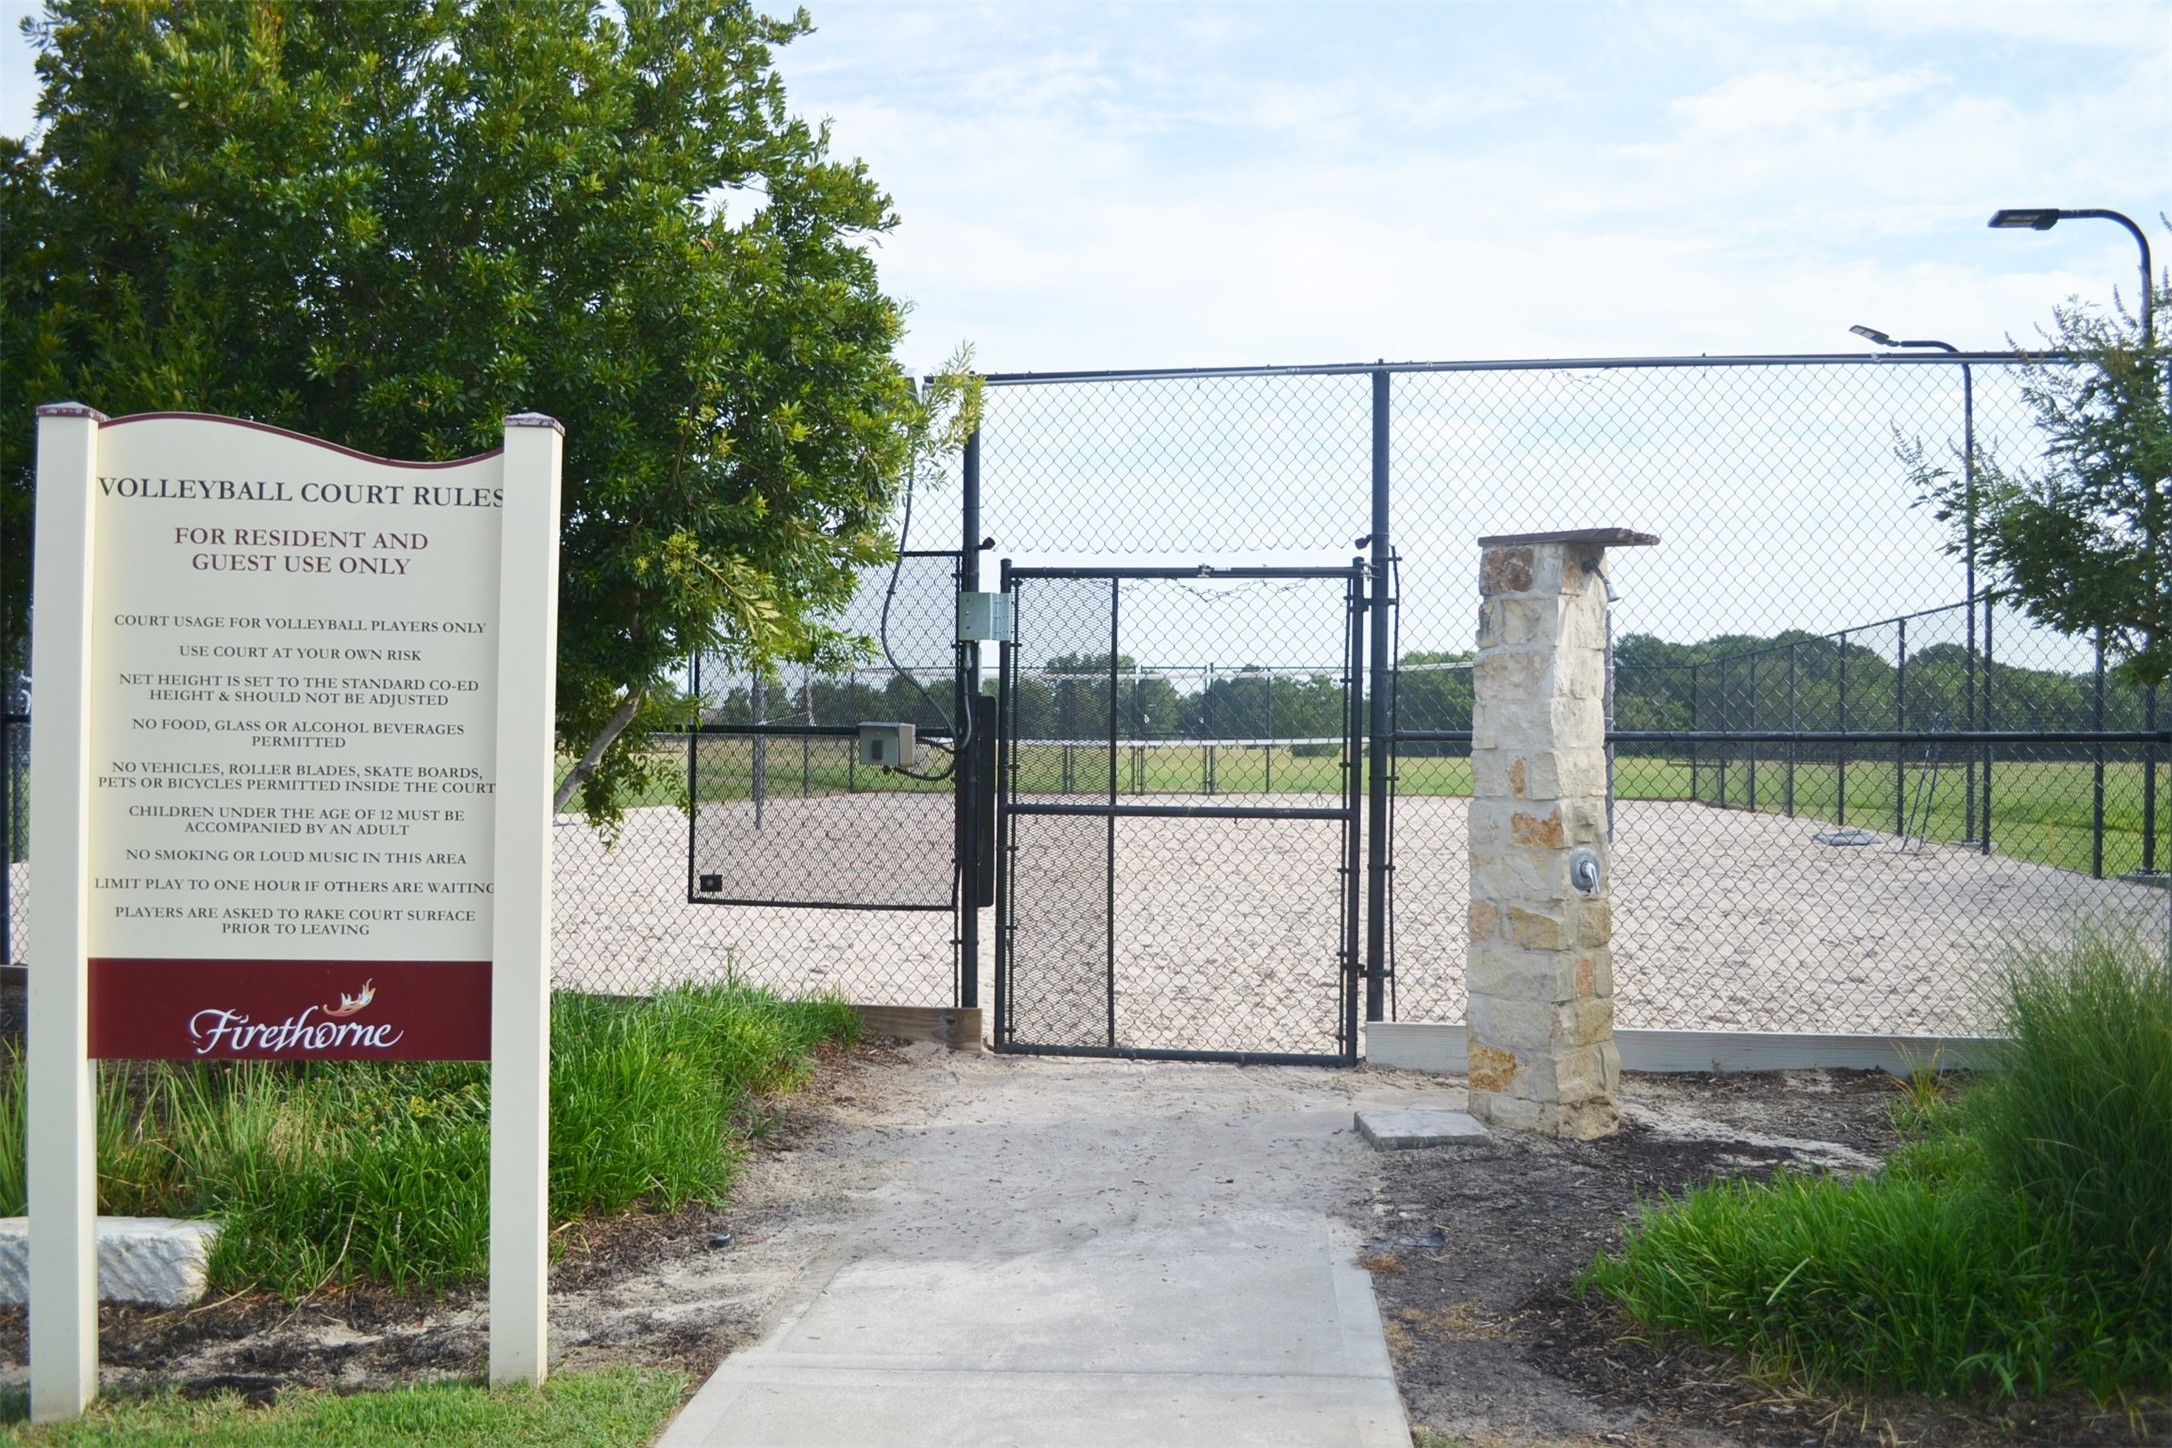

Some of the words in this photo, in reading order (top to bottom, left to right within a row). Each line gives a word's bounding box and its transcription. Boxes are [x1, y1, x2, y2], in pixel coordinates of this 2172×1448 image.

[96, 476, 294, 502] VOLLEYBALL
[300, 482, 405, 505] COURT
[412, 485, 503, 509] RULES
[173, 526, 227, 546] FOR
[233, 528, 367, 549] RESIDENT
[371, 531, 429, 551] AND
[191, 552, 277, 572] GUEST
[283, 555, 332, 574] USE
[338, 556, 412, 576] ONLY
[114, 614, 170, 627] COURT
[173, 615, 226, 628] USAGE
[228, 616, 262, 629] FOR
[264, 617, 368, 632] VOLLEYBALL
[371, 619, 439, 633] PLAYERS
[442, 621, 487, 634] ONLY
[179, 645, 210, 657] USE
[212, 645, 269, 659] COURT
[271, 647, 294, 659] AT
[295, 647, 341, 660] YOUR
[344, 648, 383, 661] OWN
[386, 649, 422, 662] RISK
[119, 672, 154, 685] NET
[157, 673, 224, 687] HEIGHT
[226, 675, 241, 687] IS
[244, 675, 274, 688] SET
[276, 676, 300, 689] TO
[302, 676, 339, 689] THE
[341, 677, 426, 691] STANDARD
[428, 679, 480, 692] CO-ED
[149, 688, 216, 702] HEIGHT
[218, 690, 231, 702] &
[234, 690, 302, 704] SHOULD
[304, 691, 341, 704] NOT
[343, 692, 366, 705] BE
[368, 693, 449, 708] ADJUSTED
[131, 718, 158, 730] NO
[161, 718, 211, 733] FOOD,
[214, 719, 262, 732] GLASS
[265, 720, 288, 733] OR
[291, 721, 370, 734] ALCOHOL
[372, 722, 465, 736] BEVERAGES
[251, 735, 347, 749] PERMITTED
[111, 761, 137, 774] NO
[140, 761, 225, 777] VEHICLES,
[228, 763, 292, 776] ROLLER
[295, 764, 361, 779] BLADES,
[363, 765, 414, 778] SKATE
[417, 766, 484, 782] BOARDS,
[98, 776, 137, 789] PETS
[140, 776, 164, 789] OR
[167, 777, 243, 791] BICYCLES
[246, 778, 342, 792] PERMITTED
[344, 780, 401, 793] INSIDE
[403, 781, 439, 794] THE
[441, 781, 496, 795] COURT
[128, 805, 215, 818] CHILDREN
[218, 806, 278, 819] UNDER
[279, 807, 316, 820] THE
[318, 808, 351, 821] AGE
[354, 808, 377, 821] OF
[379, 808, 394, 821] 12
[396, 809, 441, 822] MUST
[443, 809, 465, 822] BE
[184, 821, 302, 835] ACCOMPANIED
[305, 823, 327, 835] BY
[328, 823, 353, 835] AN
[355, 823, 410, 836] ADULT
[125, 848, 151, 861] NO
[154, 848, 229, 862] SMOKING
[232, 850, 256, 862] OR
[259, 850, 305, 863] LOUD
[308, 851, 359, 864] MUSIC
[361, 852, 381, 864] IN
[383, 852, 423, 865] THIS
[425, 852, 467, 865] AREA
[94, 877, 142, 890] LIMIT
[144, 878, 185, 890] PLAY
[187, 878, 210, 891] TO
[213, 878, 250, 891] ONE
[253, 879, 302, 892] HOUR
[303, 880, 321, 892] IF
[323, 880, 389, 893] OTHERS
[391, 881, 424, 894] ARE
[114, 906, 184, 919] PLAYERS
[186, 907, 219, 919] ARE
[222, 907, 274, 920] ASKED
[276, 907, 300, 920] TO
[303, 908, 345, 921] RAKE
[348, 908, 404, 921] COURT
[407, 909, 476, 922] SURFACE
[222, 922, 271, 935] PRIOR
[273, 922, 297, 935] TO
[300, 923, 370, 936] LEAVING
[189, 1005, 404, 1054] Firethorne
